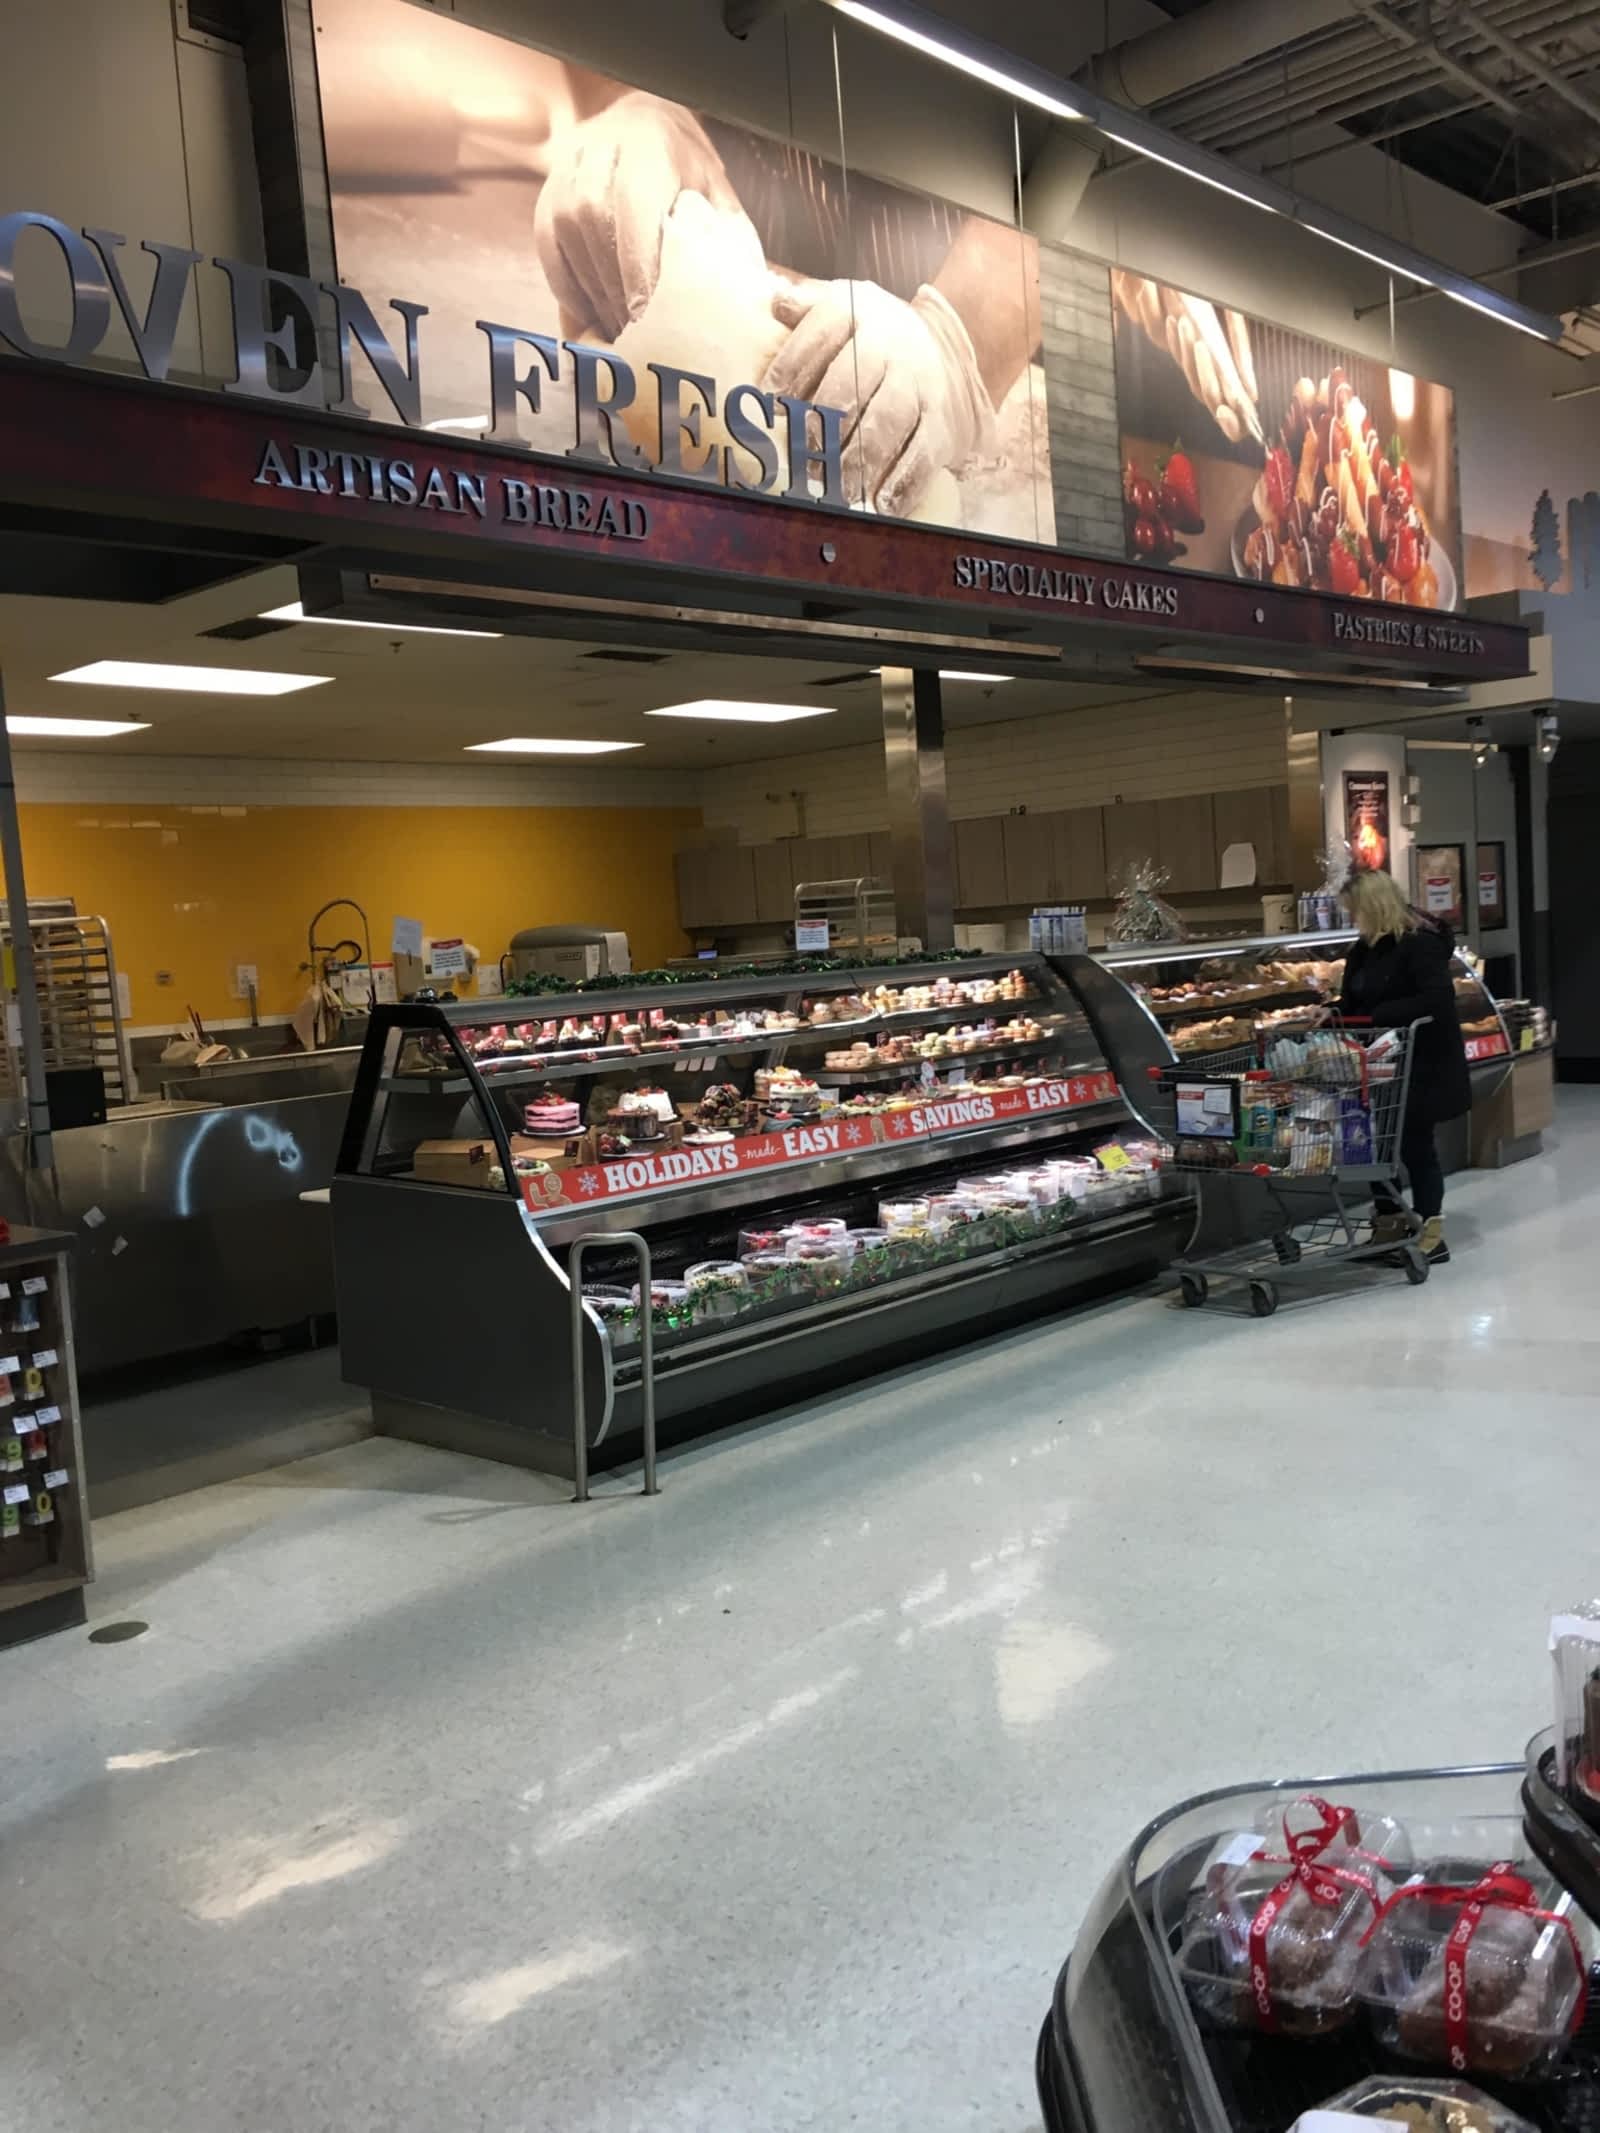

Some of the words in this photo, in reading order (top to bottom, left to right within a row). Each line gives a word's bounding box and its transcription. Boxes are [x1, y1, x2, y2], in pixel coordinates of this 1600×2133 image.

[0, 211, 429, 427] OVEN
[476, 320, 850, 509] FRESH
[253, 440, 487, 518] ARTISAN
[501, 477, 652, 541] BREAD
[955, 554, 1096, 605] SPECIALTY
[1102, 578, 1178, 616] CAKES
[1333, 612, 1411, 646] PASTRIES
[1413, 623, 1425, 648] &
[1427, 625, 1485, 653] SWEETS
[603, 1143, 739, 1192] HOLIDAYS
[782, 1124, 841, 1158] EASY
[910, 1096, 995, 1133] SAVINGS
[1026, 1083, 1070, 1109] EASY
